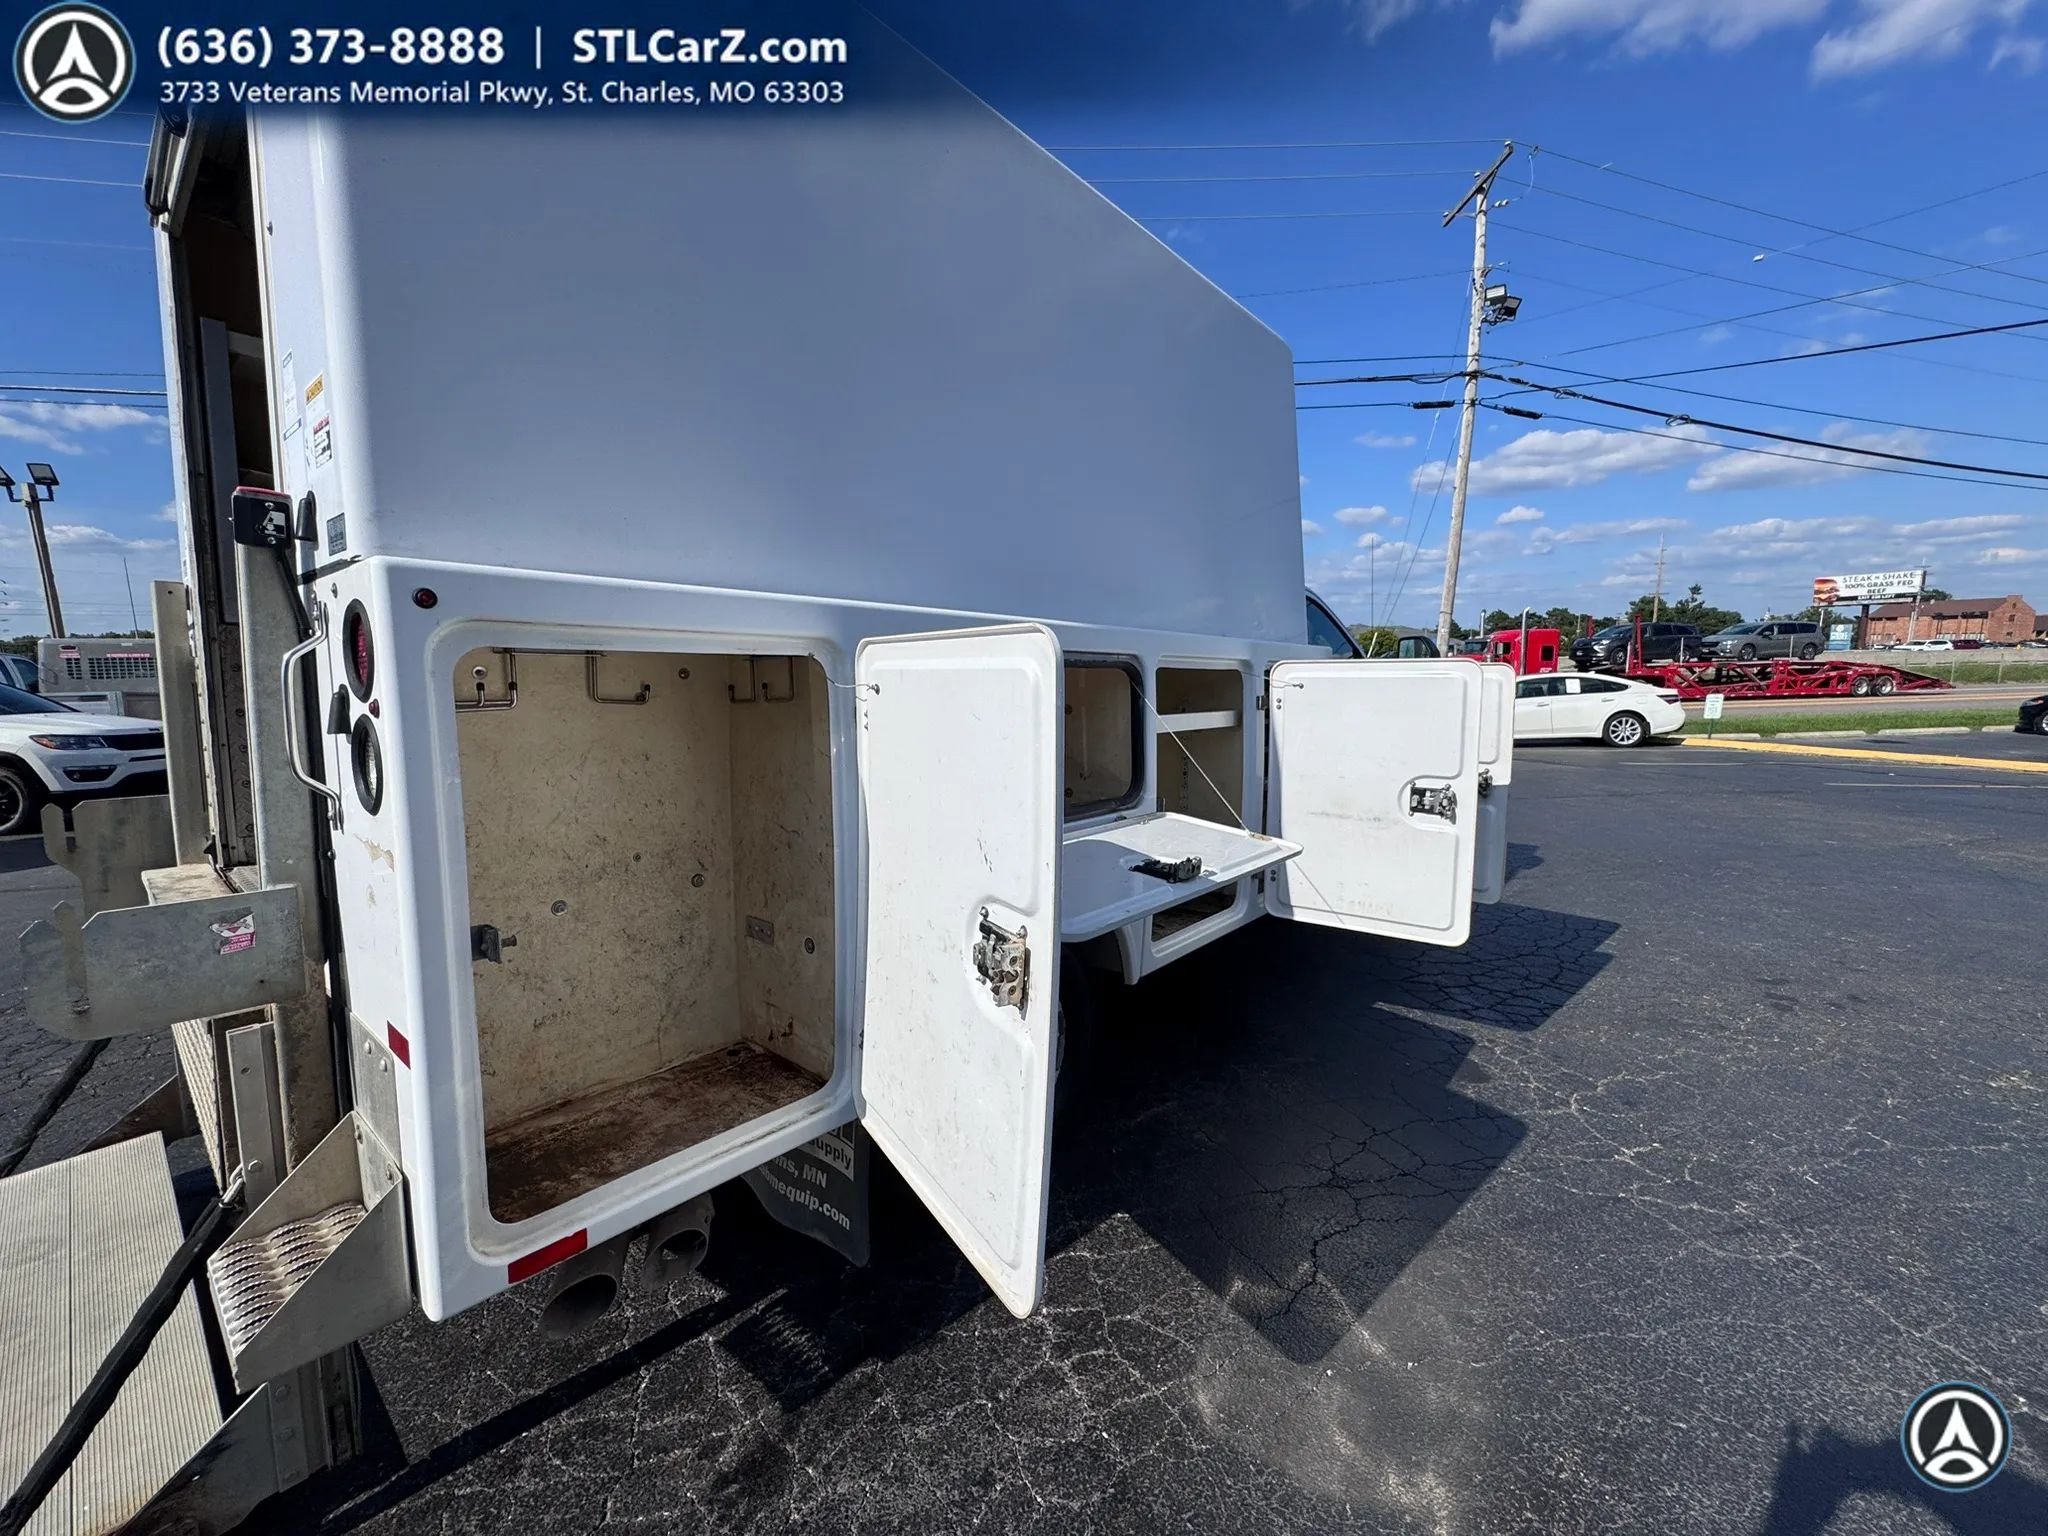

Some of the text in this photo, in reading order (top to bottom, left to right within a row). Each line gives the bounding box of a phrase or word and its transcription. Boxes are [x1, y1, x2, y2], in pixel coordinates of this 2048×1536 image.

[1842, 575, 1872, 583] STEAK
[1882, 572, 1915, 580] SHAKE
[1867, 580, 1894, 588] GRASS
[802, 1164, 828, 1189] MN
